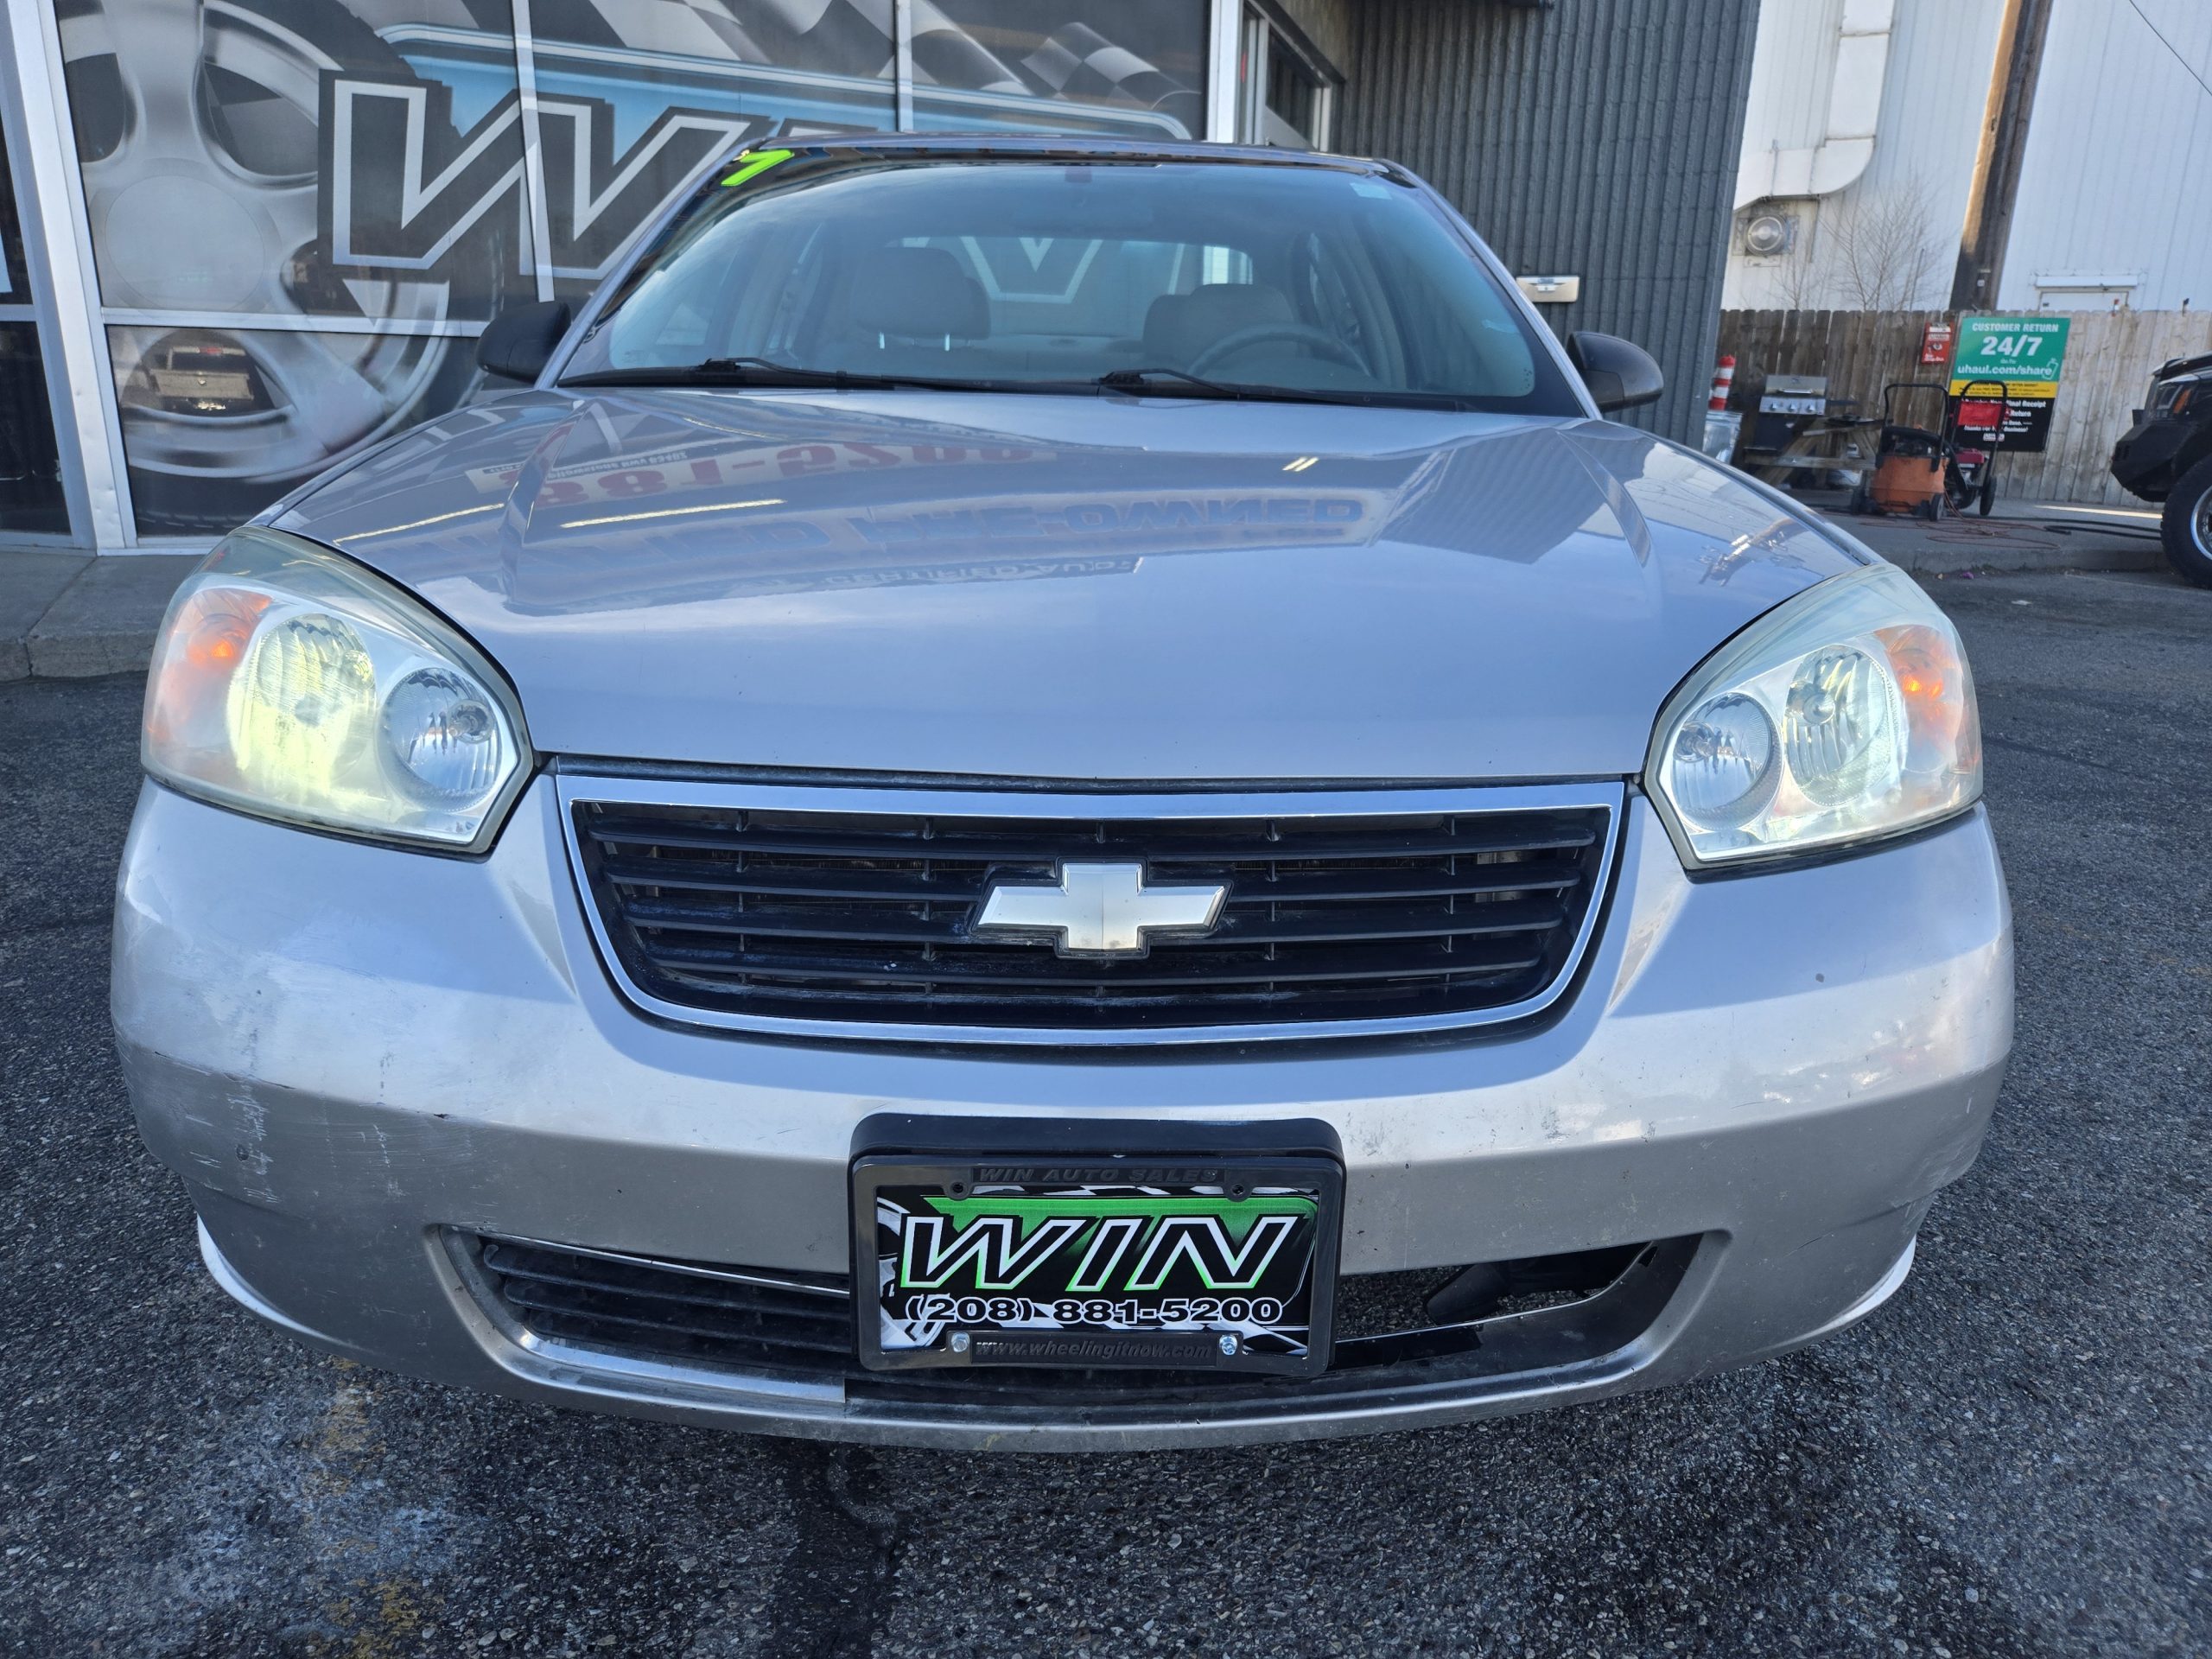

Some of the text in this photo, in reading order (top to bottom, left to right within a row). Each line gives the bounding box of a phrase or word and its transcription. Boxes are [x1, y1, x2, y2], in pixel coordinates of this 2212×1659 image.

[1972, 322, 2058, 333] CUSTOMER RETURN
[1980, 334, 2043, 357] 24/7
[1957, 364, 2053, 376] uhaul.com/share
[978, 1167, 1218, 1183] WIN AUTO SALES
[900, 1215, 1300, 1291] WIN
[905, 1296, 1283, 1325] (208) 881-5200
[975, 1339, 1211, 1361] www.wheelingitnow.com
